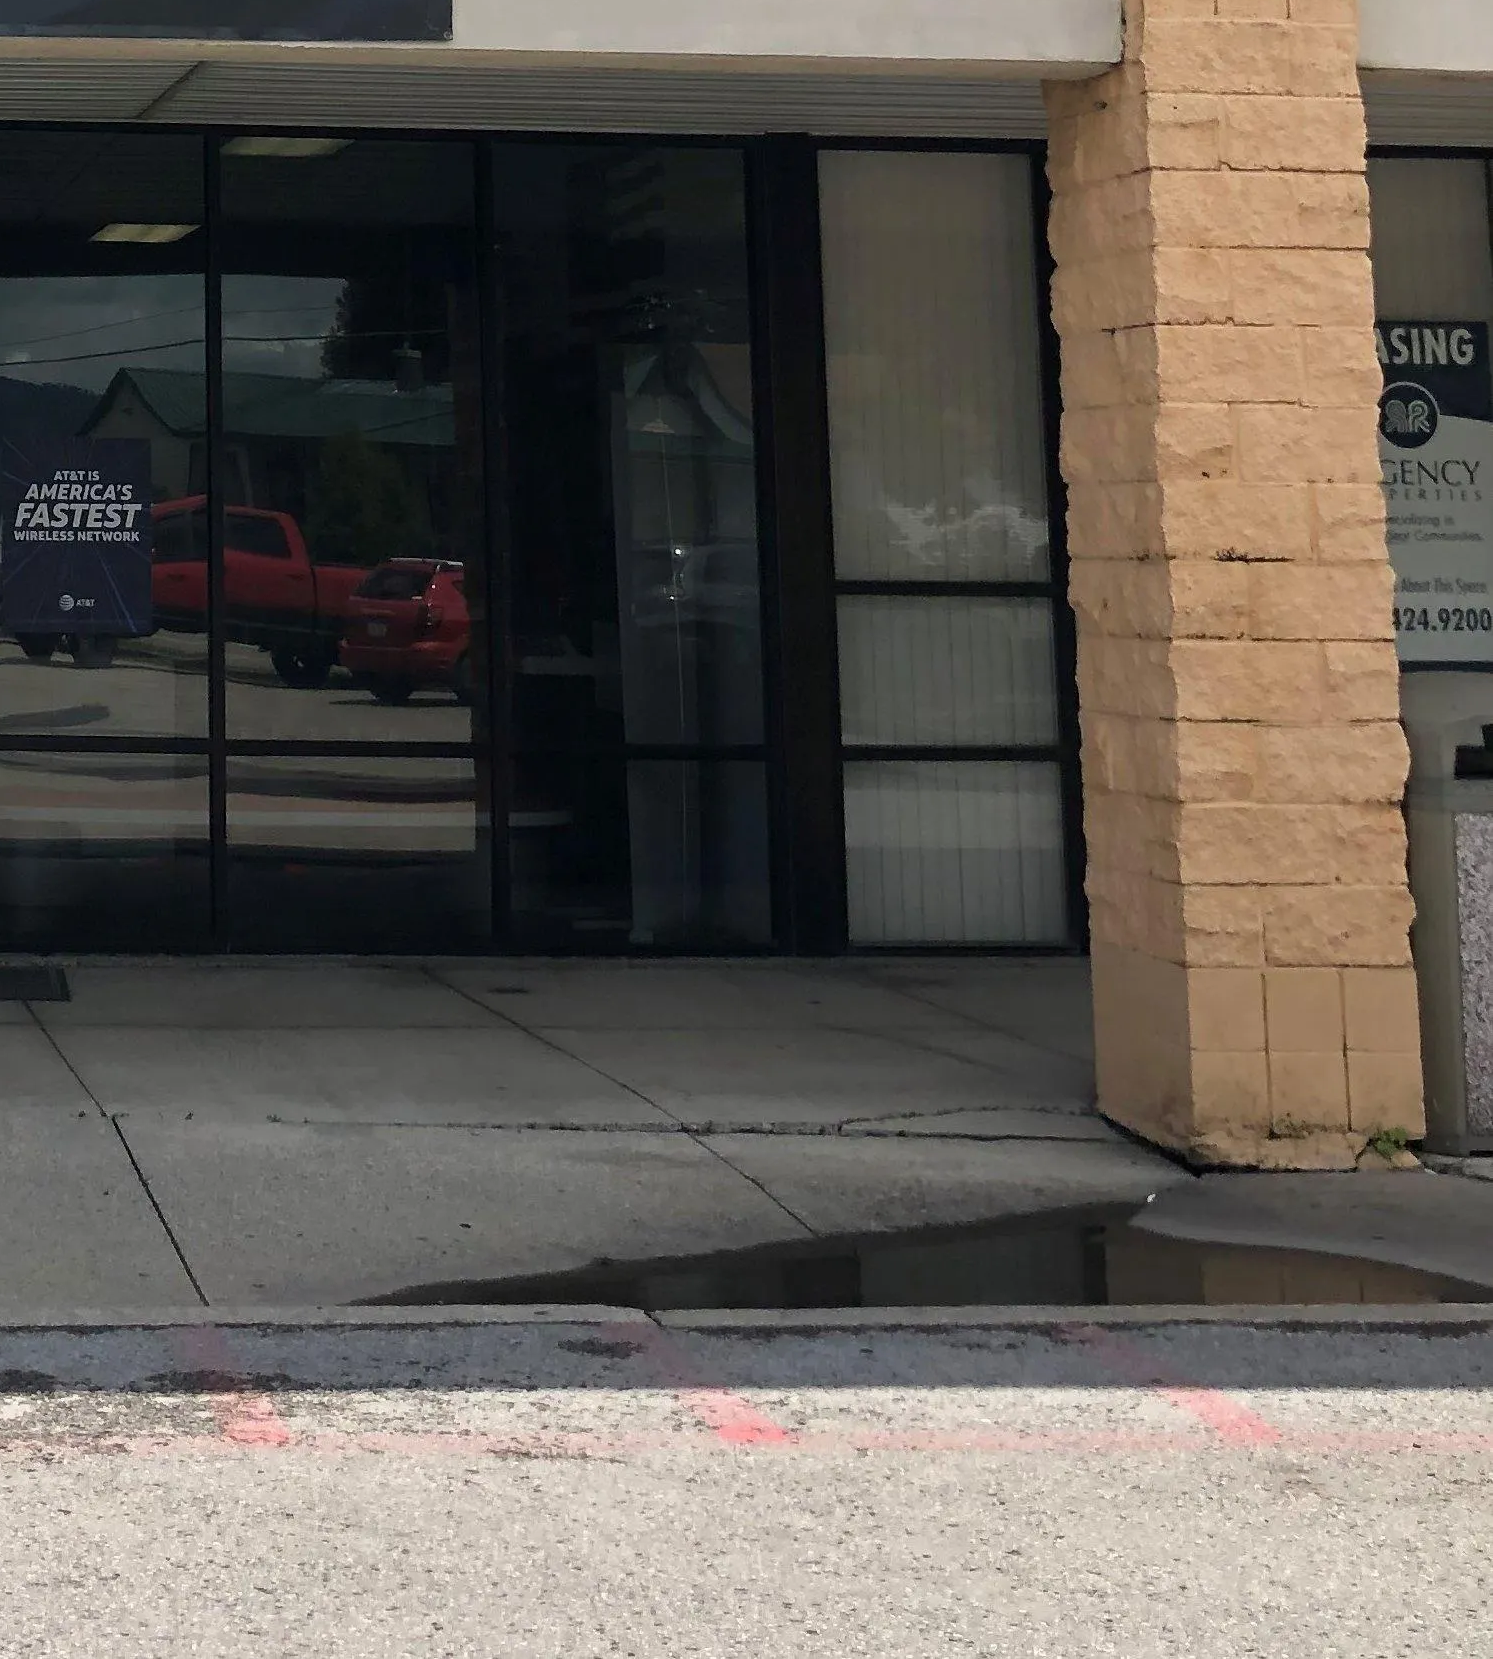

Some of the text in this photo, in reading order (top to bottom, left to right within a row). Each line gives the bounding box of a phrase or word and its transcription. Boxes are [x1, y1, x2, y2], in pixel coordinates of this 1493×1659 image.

[53, 470, 100, 481] AT&T IS
[25, 483, 133, 501] AMERICA'S
[14, 502, 143, 528] FASTEST
[13, 530, 140, 542] WIRELESS NETWORK
[75, 599, 96, 608] AT&T
